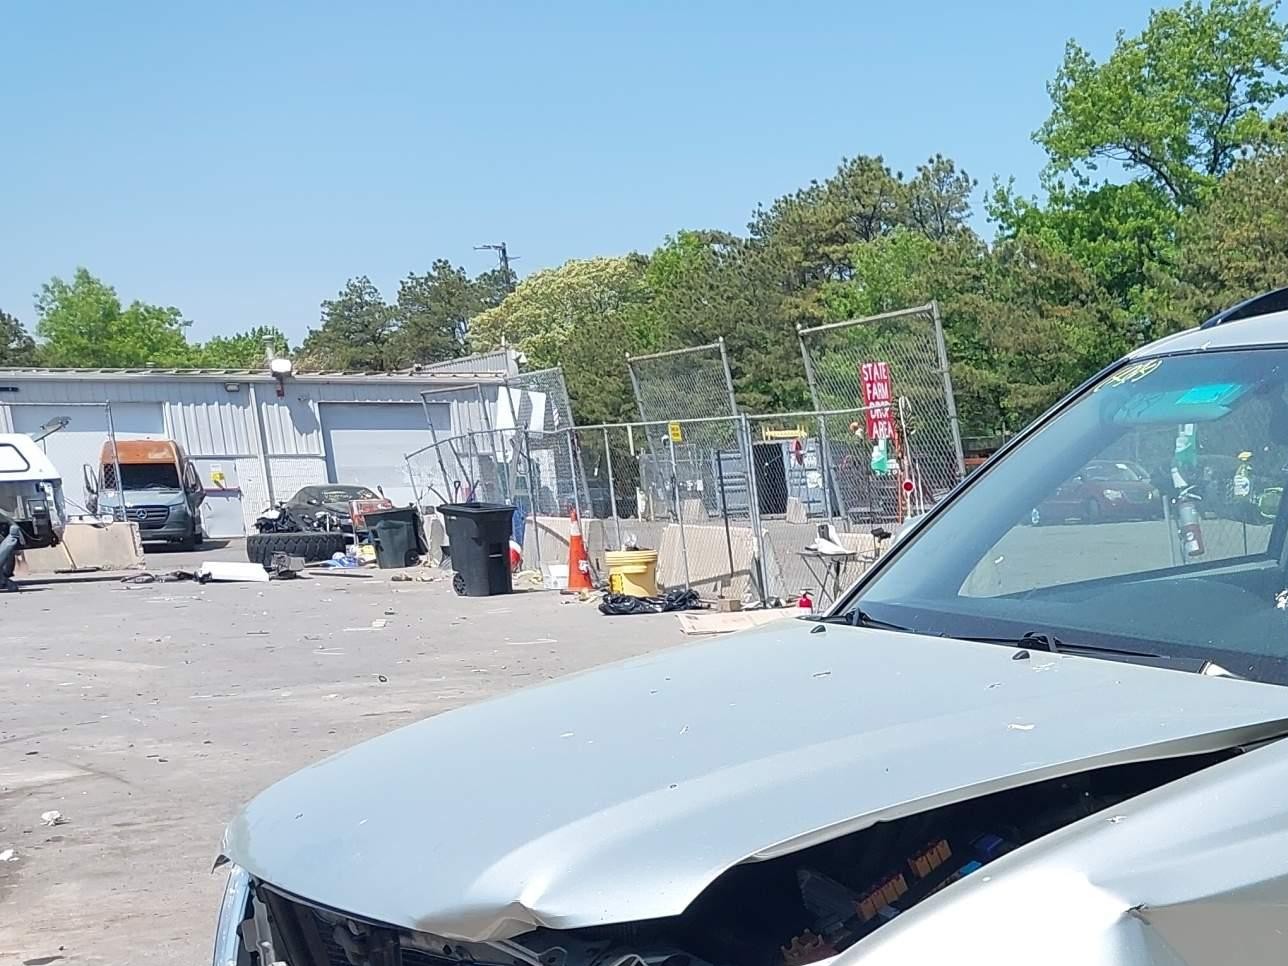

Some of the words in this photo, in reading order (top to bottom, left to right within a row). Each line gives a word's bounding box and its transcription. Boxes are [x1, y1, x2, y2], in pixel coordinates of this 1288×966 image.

[862, 362, 888, 381] STATE
[866, 381, 889, 401] FARM
[872, 420, 895, 440] AREA
